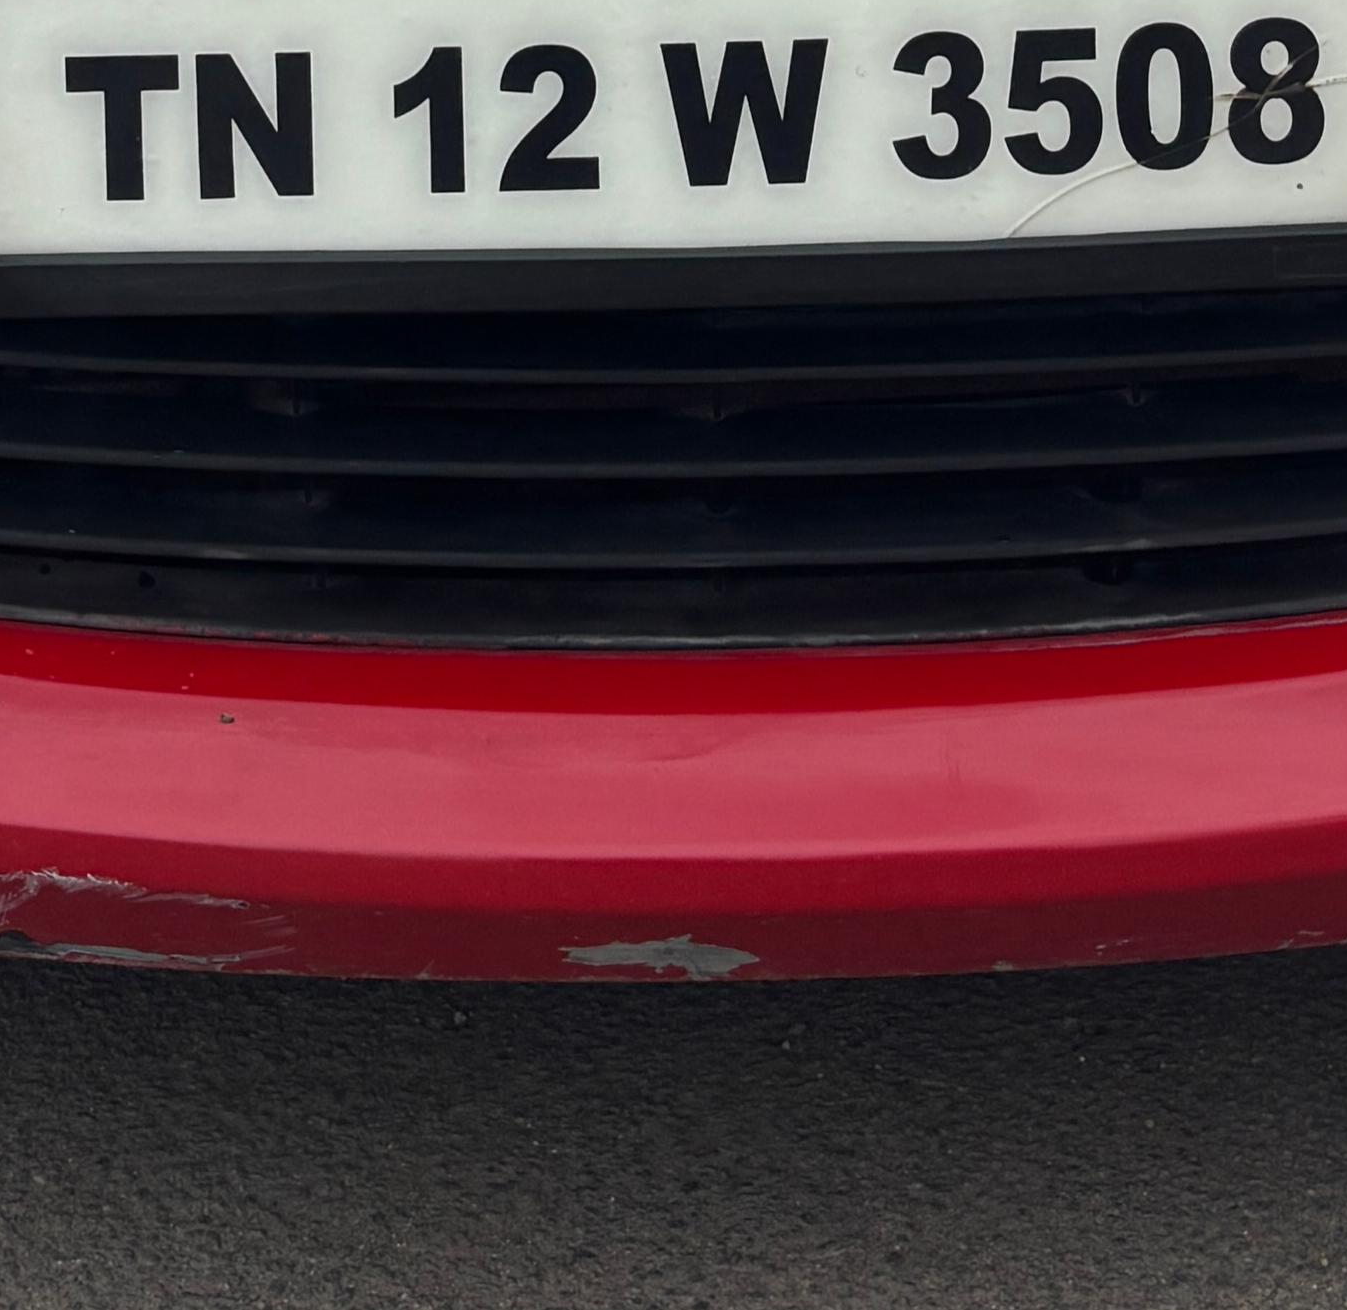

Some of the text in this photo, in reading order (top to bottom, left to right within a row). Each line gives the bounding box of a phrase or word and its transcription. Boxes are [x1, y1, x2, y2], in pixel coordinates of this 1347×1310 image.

[65, 18, 1325, 200] TN 12 W 3508
